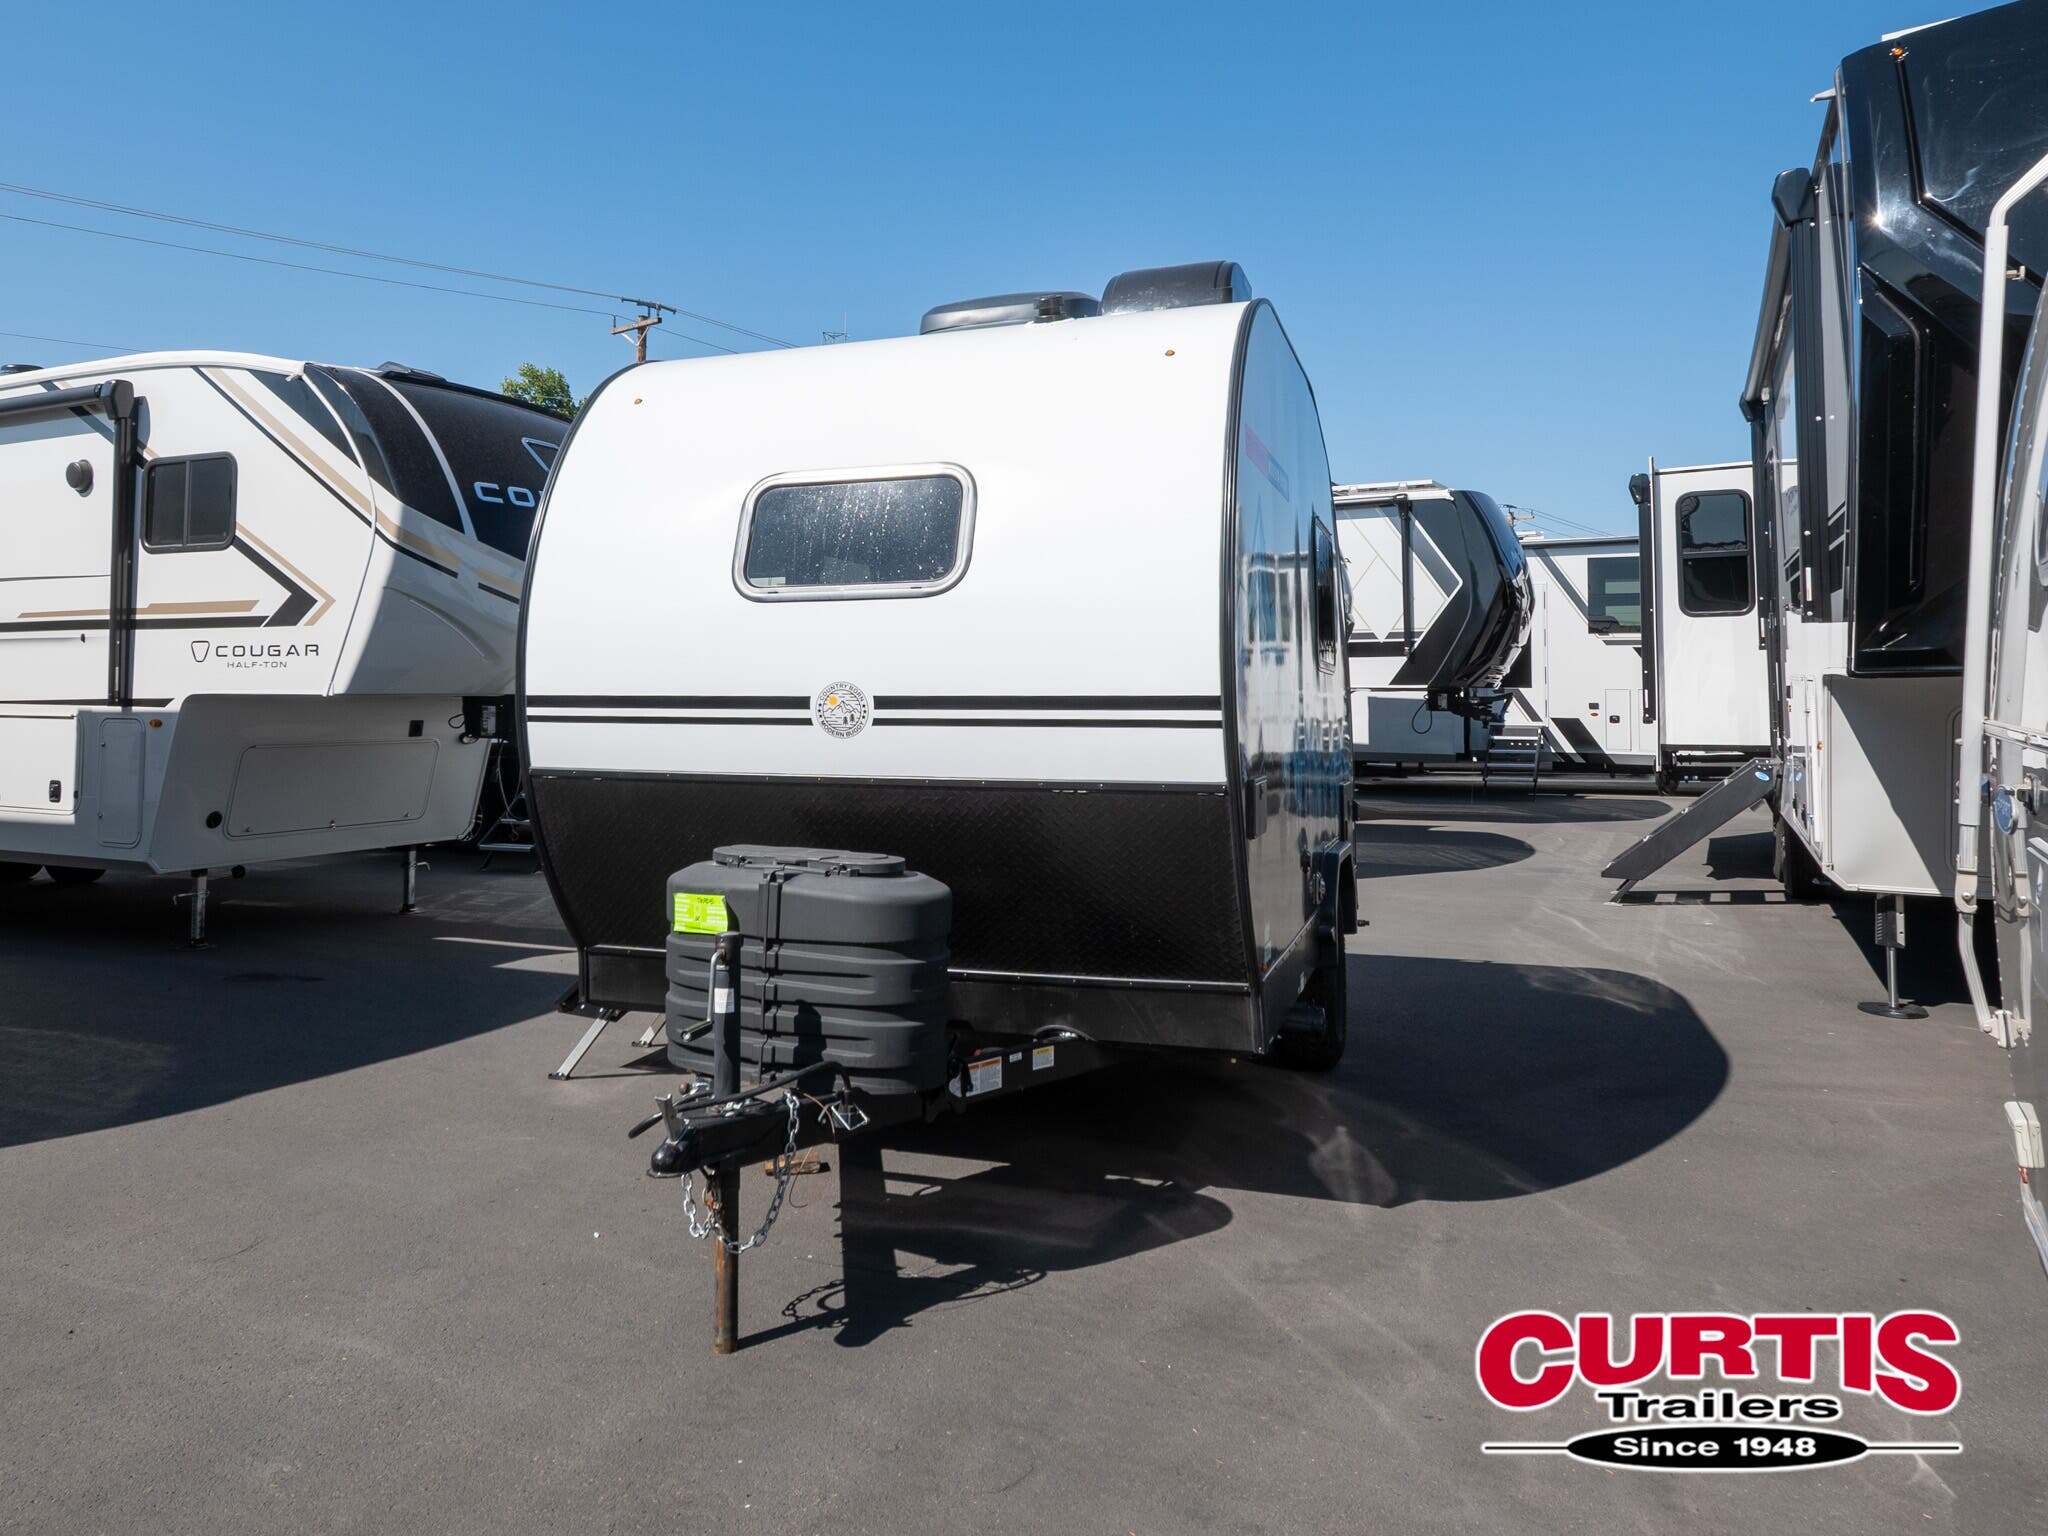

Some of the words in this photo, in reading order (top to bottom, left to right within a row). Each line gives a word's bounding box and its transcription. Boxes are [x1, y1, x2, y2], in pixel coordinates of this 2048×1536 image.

[473, 481, 545, 507] CO
[215, 644, 319, 657] COUGAR
[226, 661, 288, 669] HALF-TON
[820, 683, 848, 701] COUNTRY
[820, 720, 845, 738] MODERN
